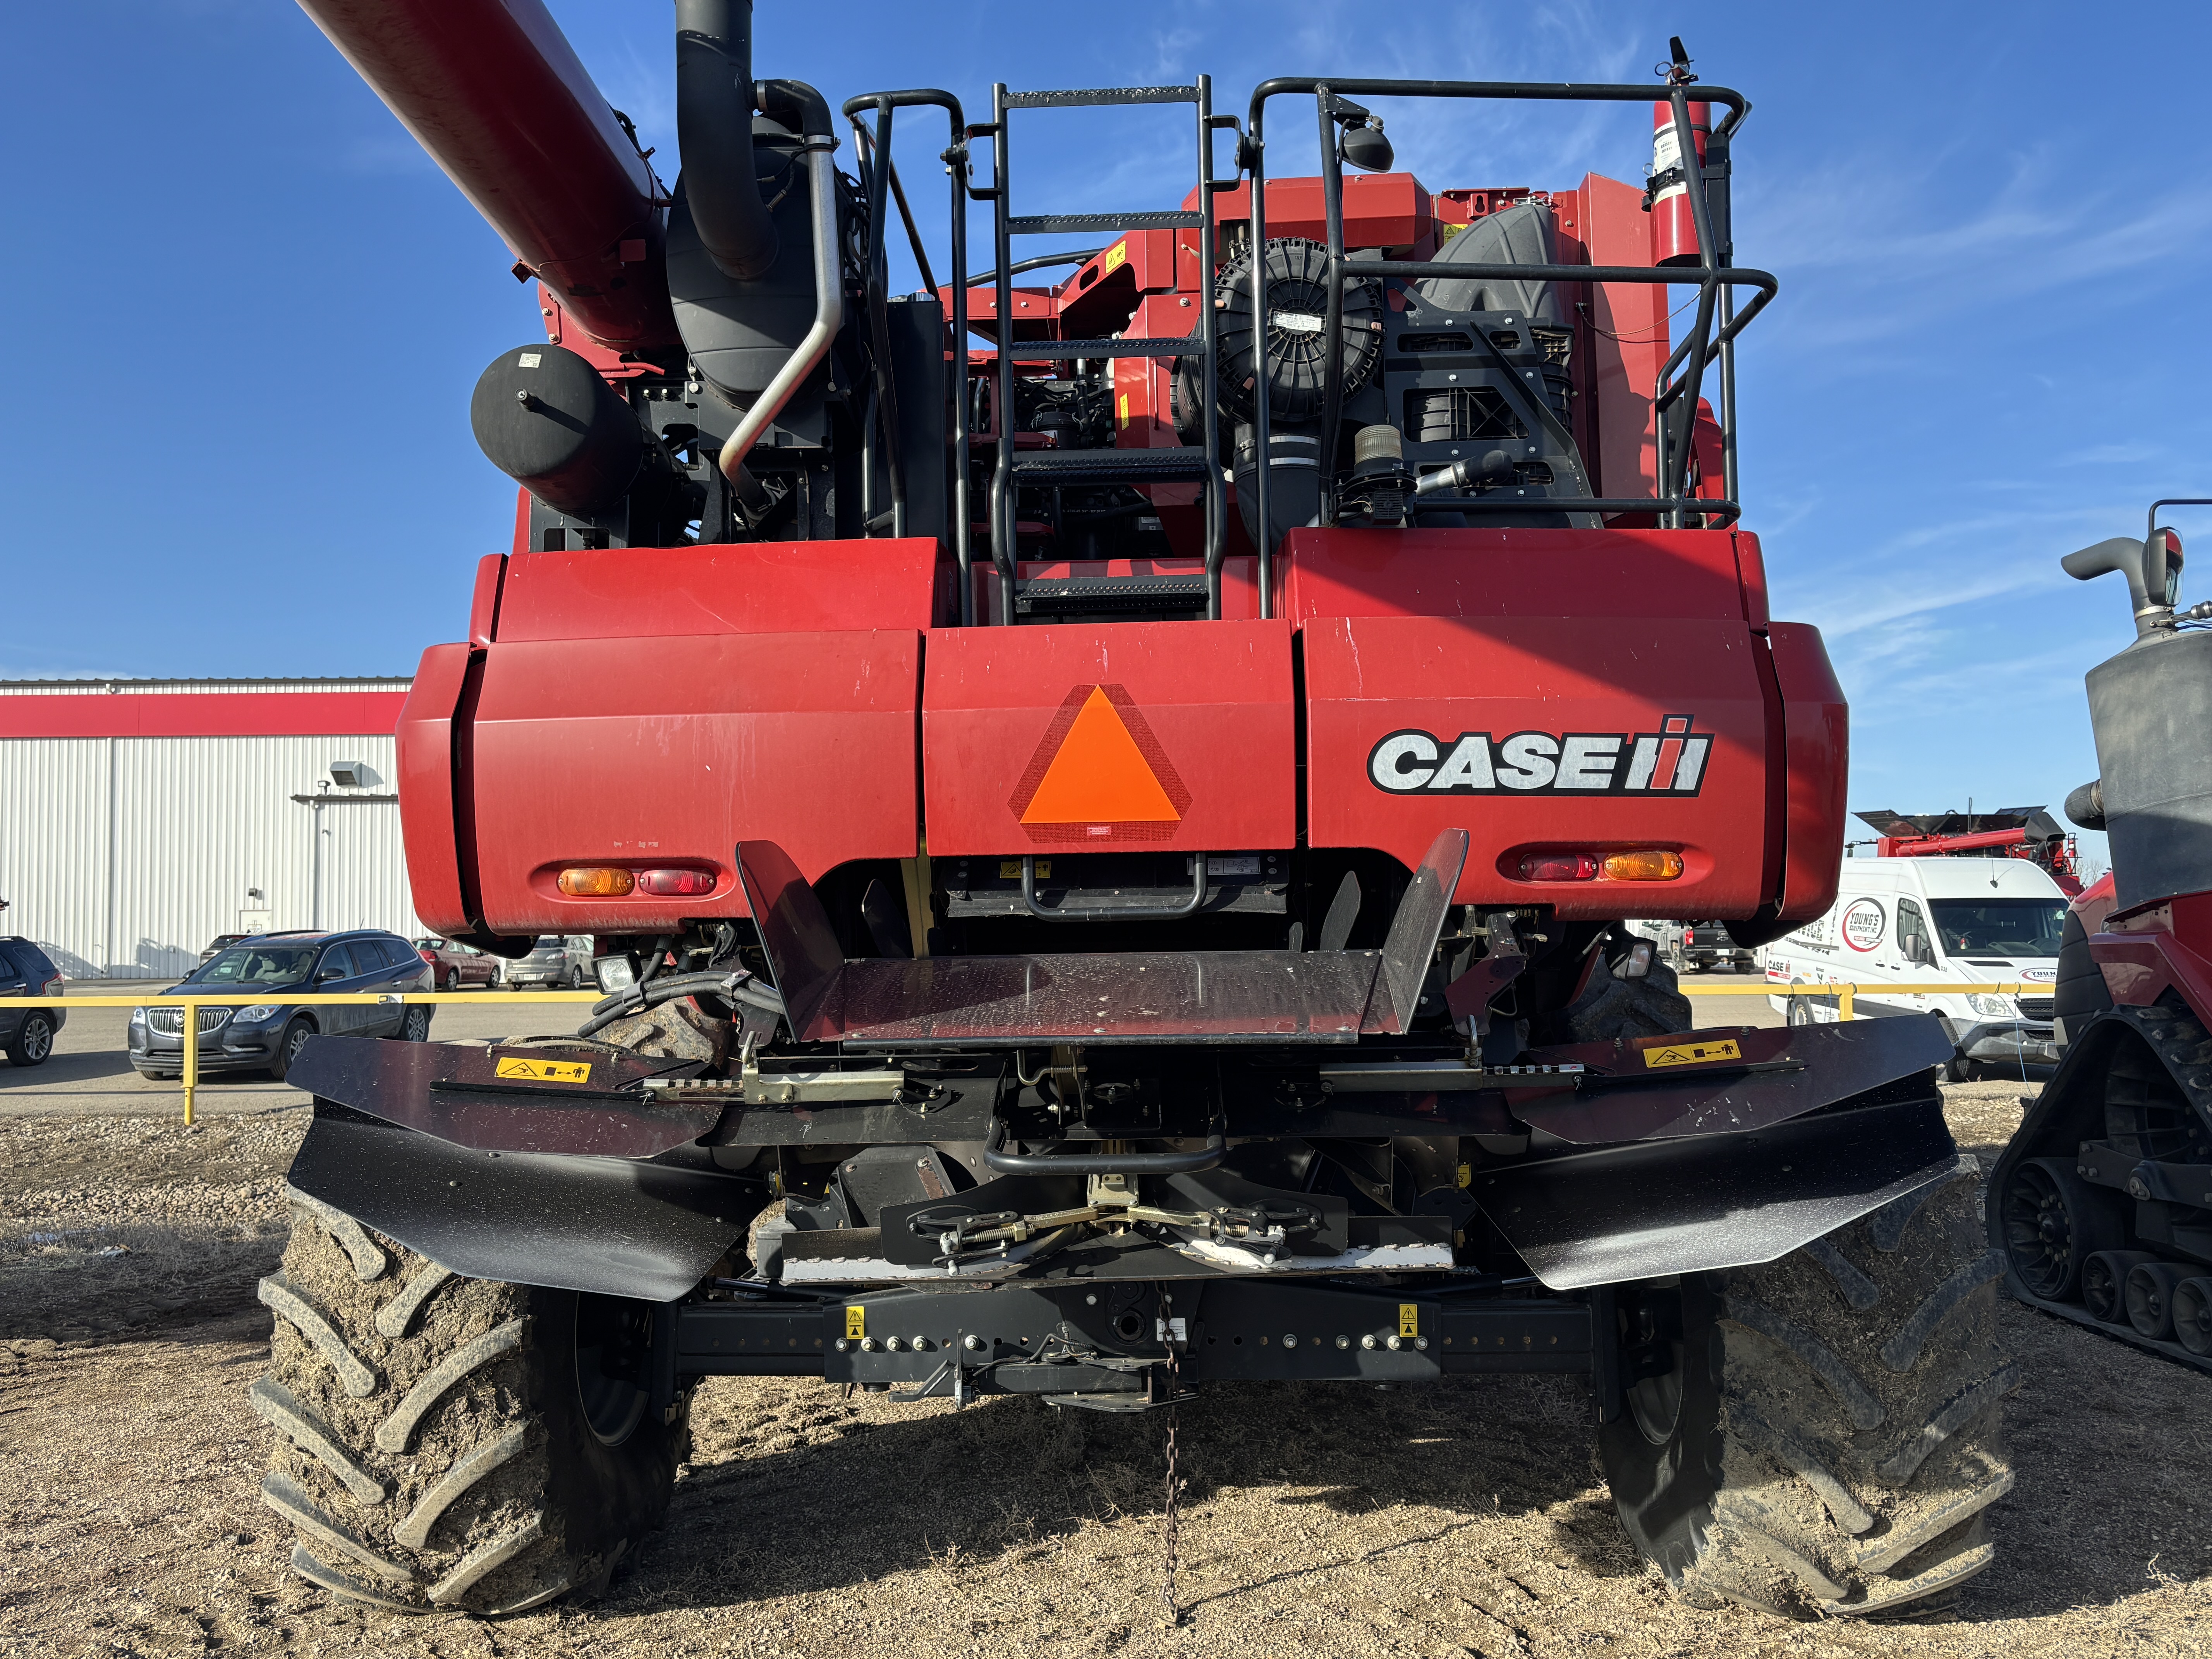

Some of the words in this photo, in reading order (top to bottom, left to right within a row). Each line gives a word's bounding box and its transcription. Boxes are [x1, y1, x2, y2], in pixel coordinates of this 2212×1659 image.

[1373, 734, 1621, 789] CASE
[1625, 718, 1708, 789] IH
[1850, 913, 1879, 926] YOUNG'S
[1768, 960, 1784, 972] CASE
